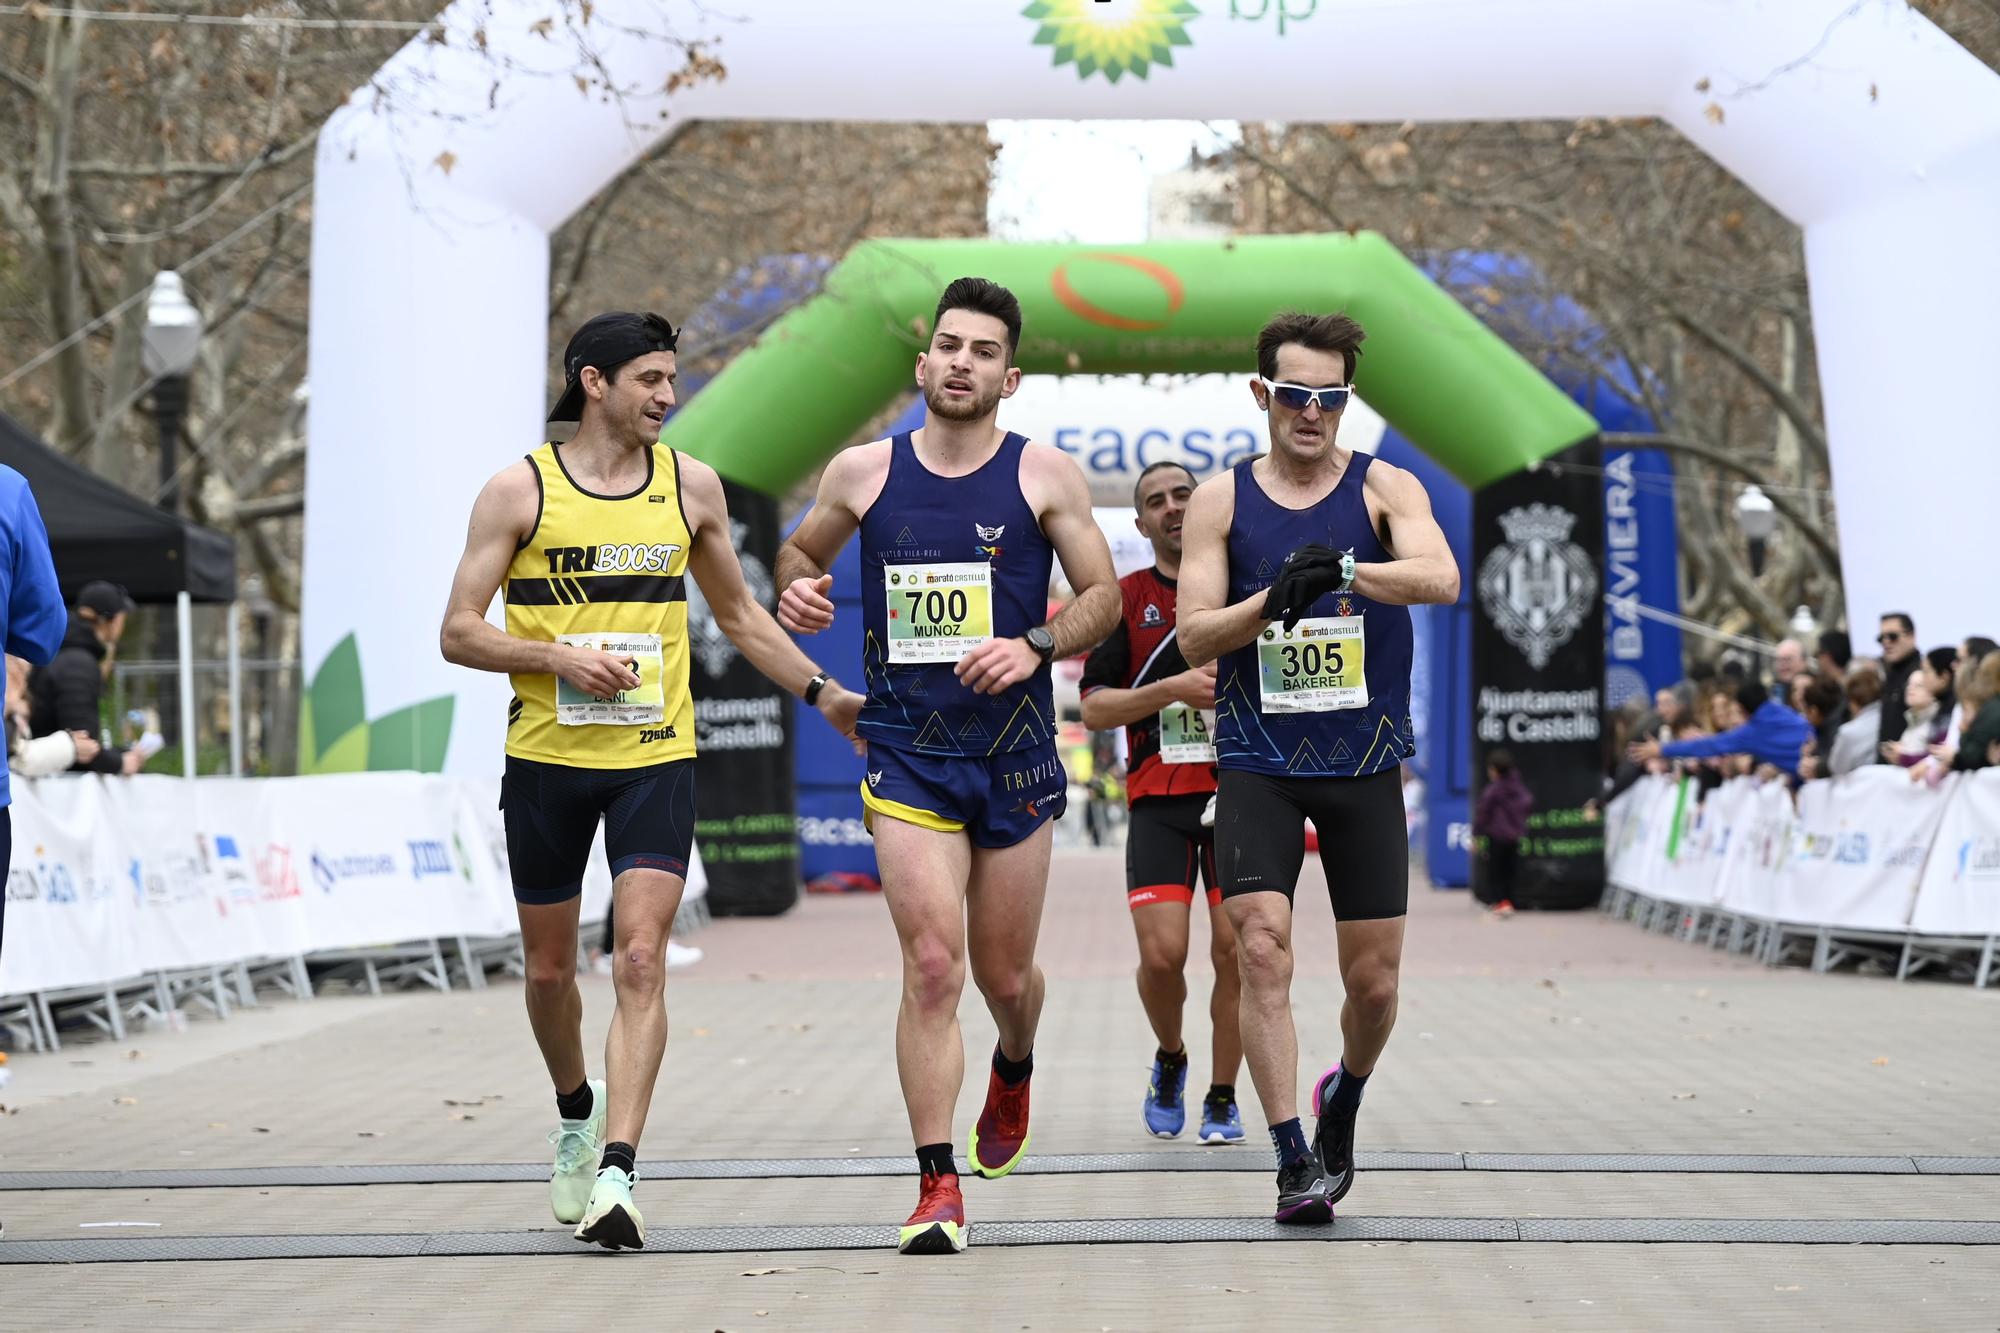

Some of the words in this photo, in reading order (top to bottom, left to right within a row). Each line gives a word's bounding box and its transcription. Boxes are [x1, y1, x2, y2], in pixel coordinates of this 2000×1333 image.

[544, 543, 681, 573] TRIBOOST
[1605, 451, 1644, 660] BAVIERA
[926, 573, 953, 584] marató
[954, 573, 985, 582] CASTELLÓ
[905, 589, 967, 624] 700
[1302, 627, 1328, 638] marató
[1329, 626, 1359, 635] CASTELLÓ
[628, 643, 657, 652] CASTELLÓ
[1280, 642, 1343, 678] 305
[1283, 675, 1344, 690] BAKERET
[1478, 686, 1599, 714] Ajuntament
[1478, 713, 1505, 742] de
